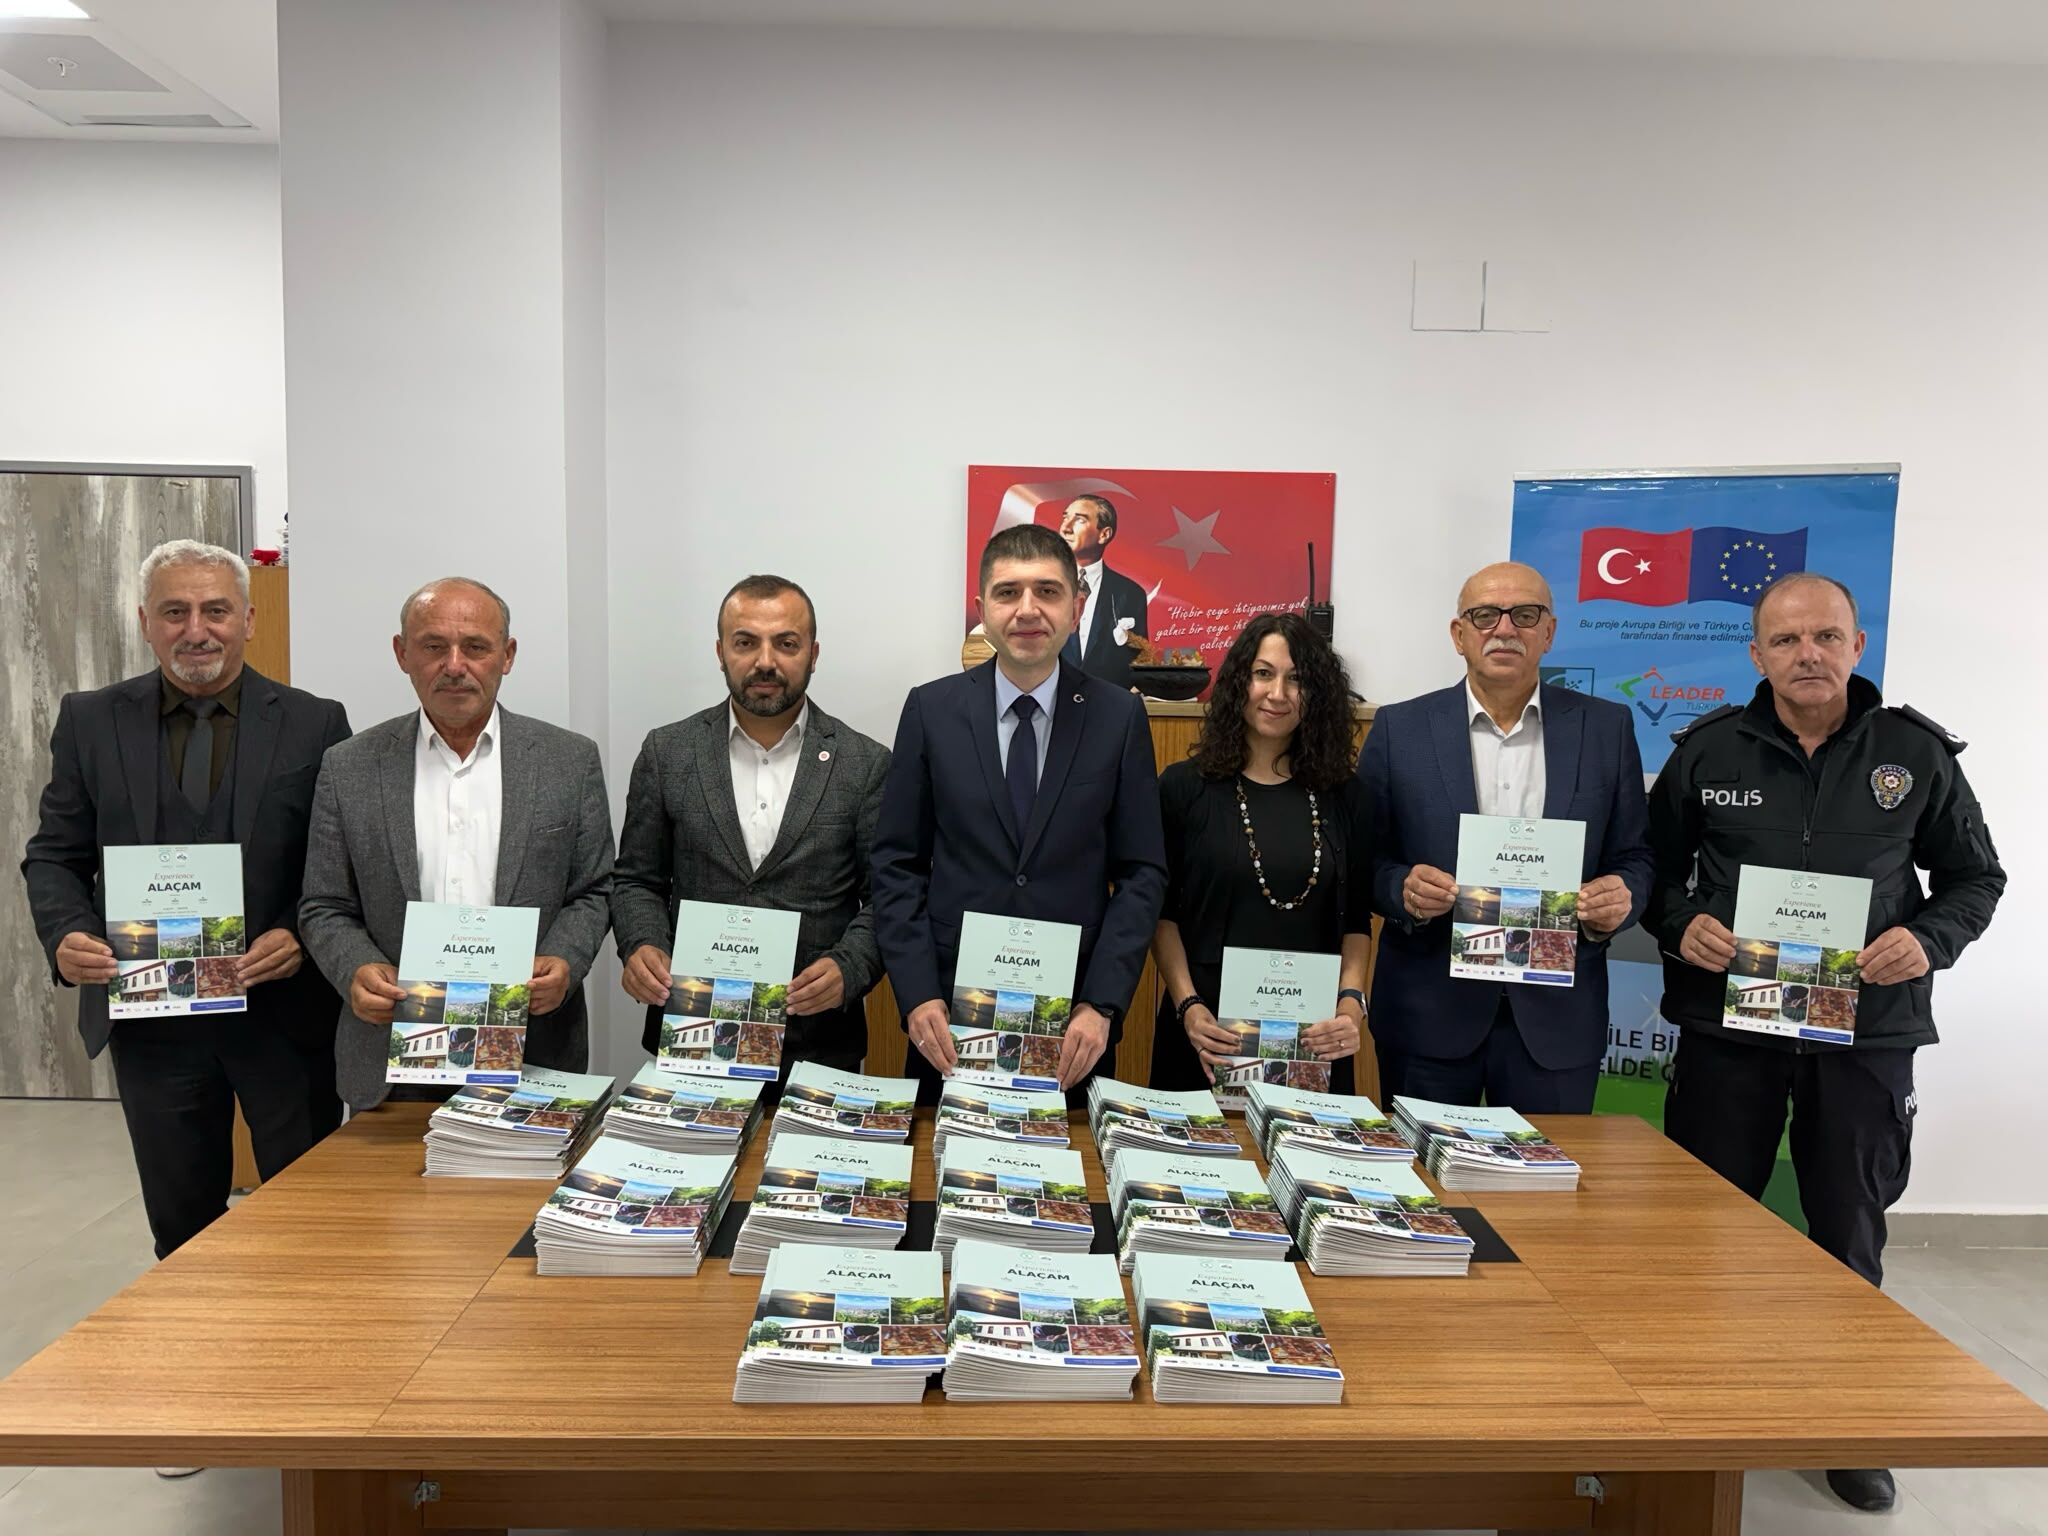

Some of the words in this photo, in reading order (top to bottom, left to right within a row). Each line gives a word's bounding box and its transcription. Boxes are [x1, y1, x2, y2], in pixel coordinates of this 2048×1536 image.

[1206, 608, 1229, 619] şeye
[1288, 596, 1308, 613] yok
[1189, 622, 1203, 634] bir
[1206, 625, 1229, 636] şeye
[1579, 619, 1593, 628] Bu
[1594, 620, 1619, 631] proje
[1621, 620, 1656, 631] Avrupa
[1658, 621, 1686, 632] Birliği
[1688, 622, 1701, 630] ve
[1703, 621, 1739, 632] Türkiye
[1620, 631, 1670, 641] tarafından
[1672, 632, 1708, 641] finanse
[1651, 685, 1726, 701] LEADER
[1496, 852, 1545, 864] ALAÇAM
[147, 881, 202, 893] ALAÇAM
[1775, 907, 1827, 920] ALAÇAM
[442, 944, 496, 956] ALAÇAM
[711, 942, 759, 955] ALAÇAM
[994, 954, 1041, 968] ALAÇAM
[1256, 986, 1302, 998] ALAÇAM
[827, 1269, 892, 1280] ALAÇAM
[1007, 1268, 1070, 1281] ALAÇAM
[1191, 1279, 1255, 1290] ALAÇAM
